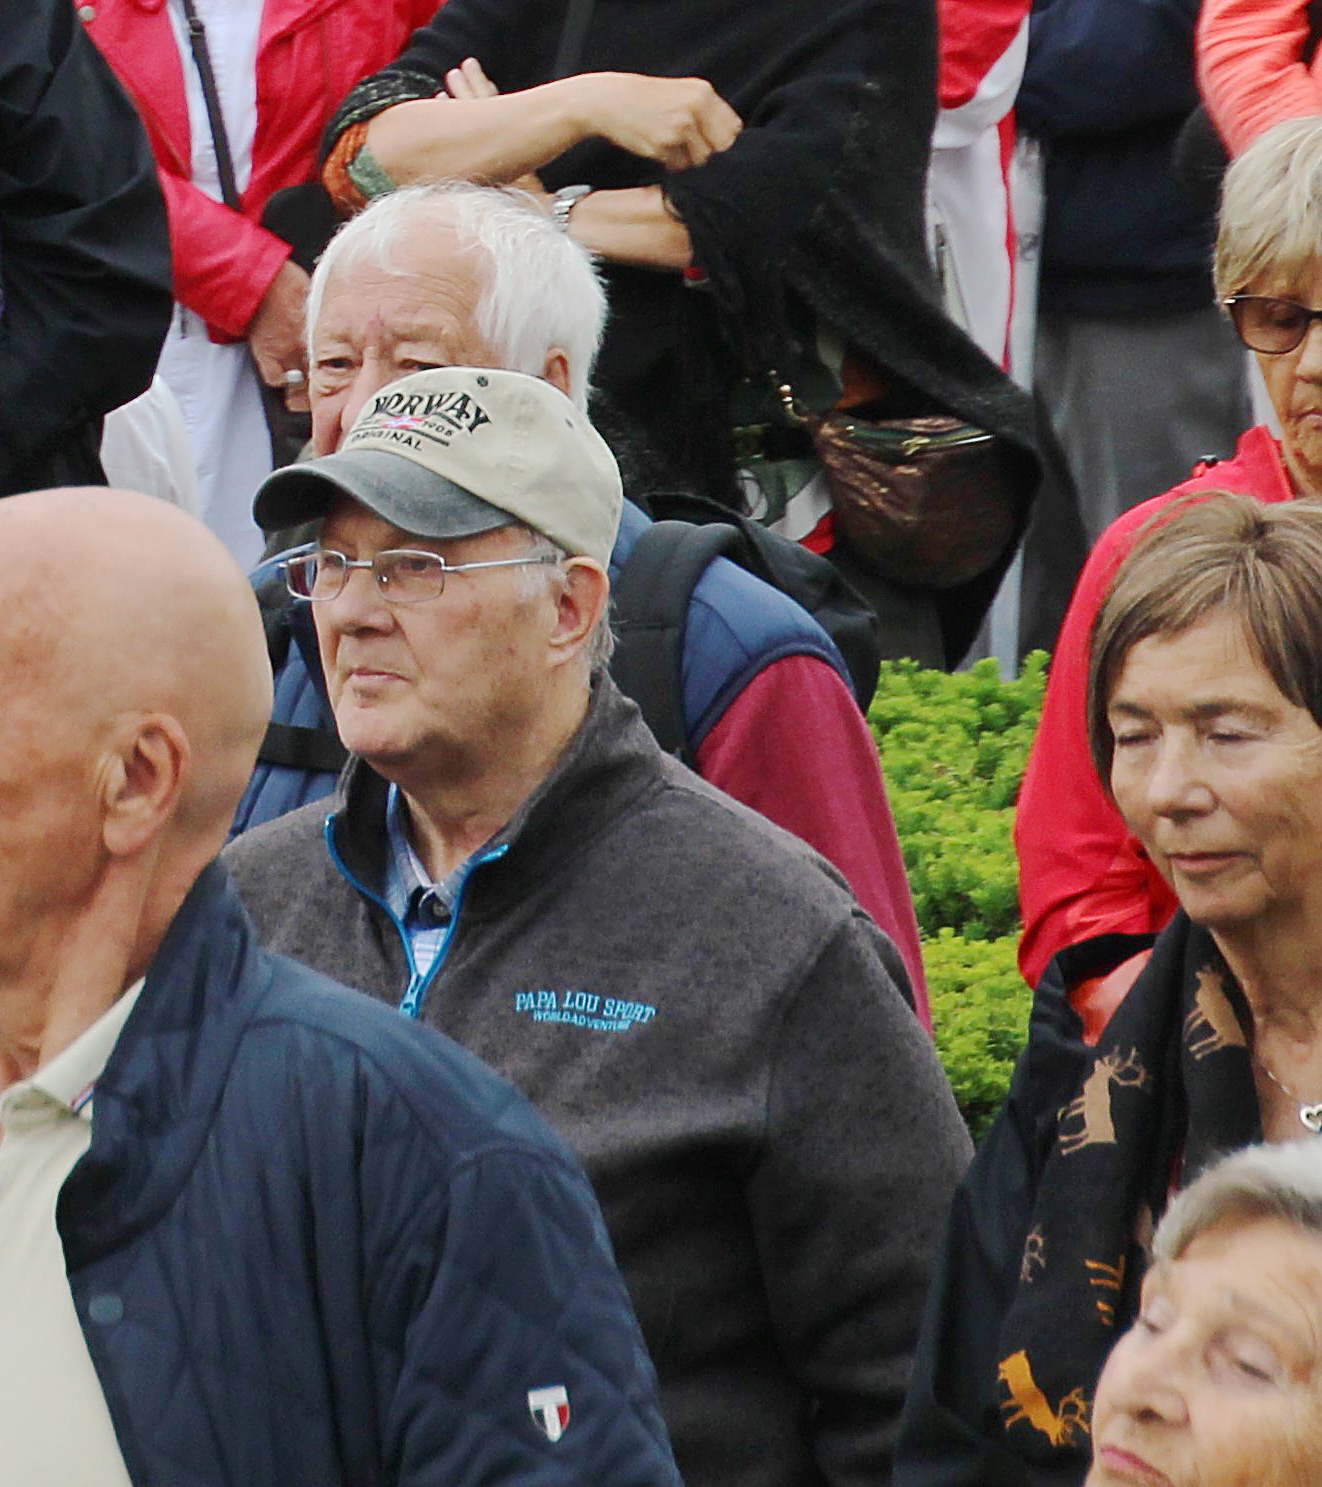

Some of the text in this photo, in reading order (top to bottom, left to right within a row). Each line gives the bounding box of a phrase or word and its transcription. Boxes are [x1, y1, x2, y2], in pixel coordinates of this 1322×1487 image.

[371, 391, 492, 434] NORWAY
[515, 989, 658, 1024] PAPA LOU SPORT
